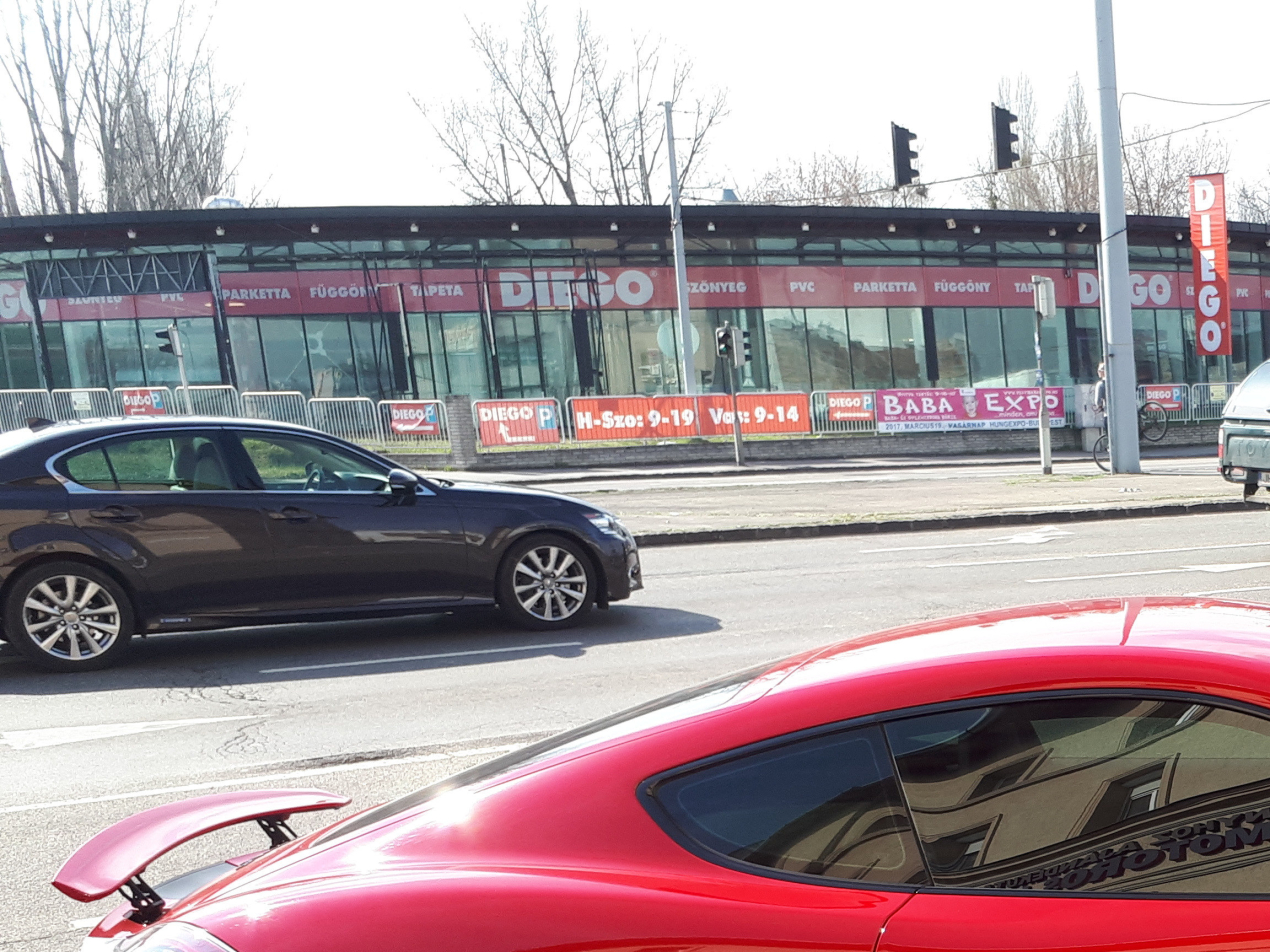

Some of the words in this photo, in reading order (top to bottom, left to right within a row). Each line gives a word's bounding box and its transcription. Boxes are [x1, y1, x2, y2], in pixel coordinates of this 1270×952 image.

[1194, 179, 1222, 353] DIEGO
[410, 285, 464, 297] TAPETA
[499, 270, 654, 307] DIEGO
[790, 281, 815, 292] PVC
[853, 281, 917, 293] PARKETTA
[1014, 282, 1034, 293] TAP
[1077, 272, 1172, 306] DGO
[1236, 287, 1249, 298] PVC
[222, 287, 291, 300] PARKETTA
[1147, 390, 1171, 399] DIEGO
[829, 398, 861, 408] DIEGO
[883, 395, 954, 415] BABA
[984, 393, 1059, 412] EXPO
[392, 408, 424, 420] DIEGO
[479, 406, 534, 421] DIEGO
[539, 408, 553, 428] P
[577, 410, 643, 429] H-Szo:
[649, 408, 695, 428] 9-19
[754, 405, 799, 423] 9-14
